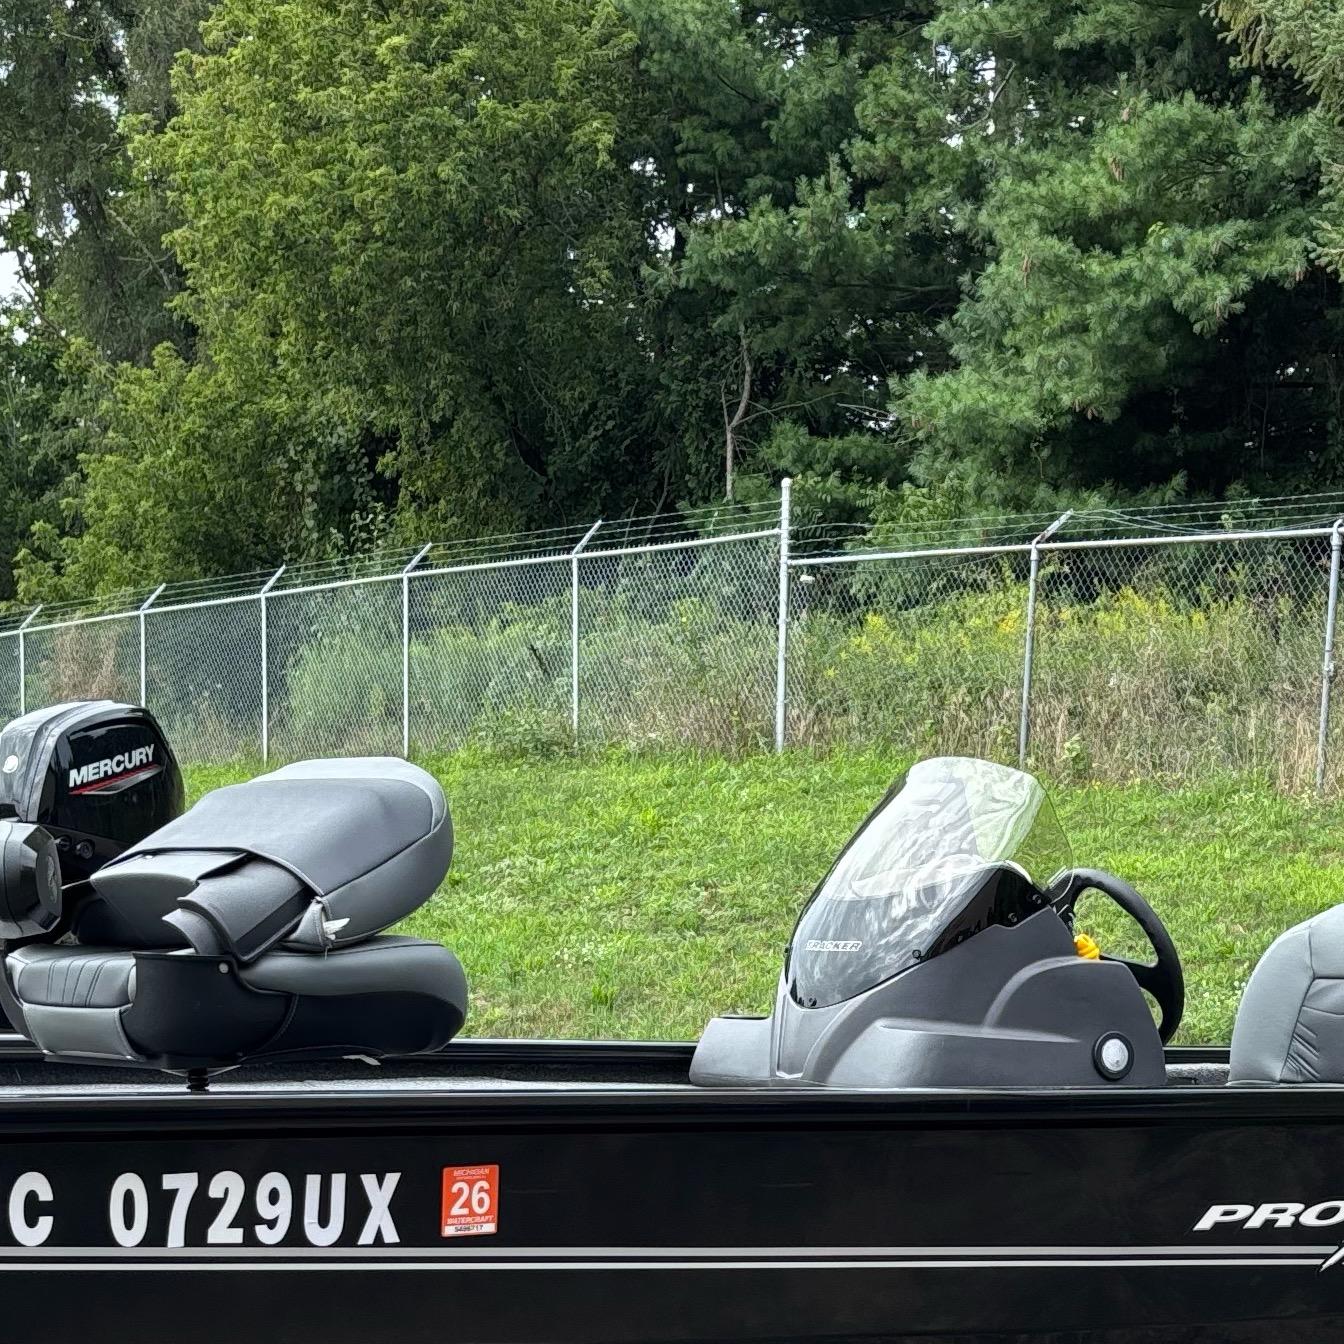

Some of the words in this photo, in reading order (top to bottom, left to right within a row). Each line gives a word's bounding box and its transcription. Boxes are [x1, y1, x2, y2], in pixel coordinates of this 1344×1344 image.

[68, 743, 155, 788] MERCURY
[109, 1170, 402, 1248] 0729UX
[450, 1180, 491, 1216] 26
